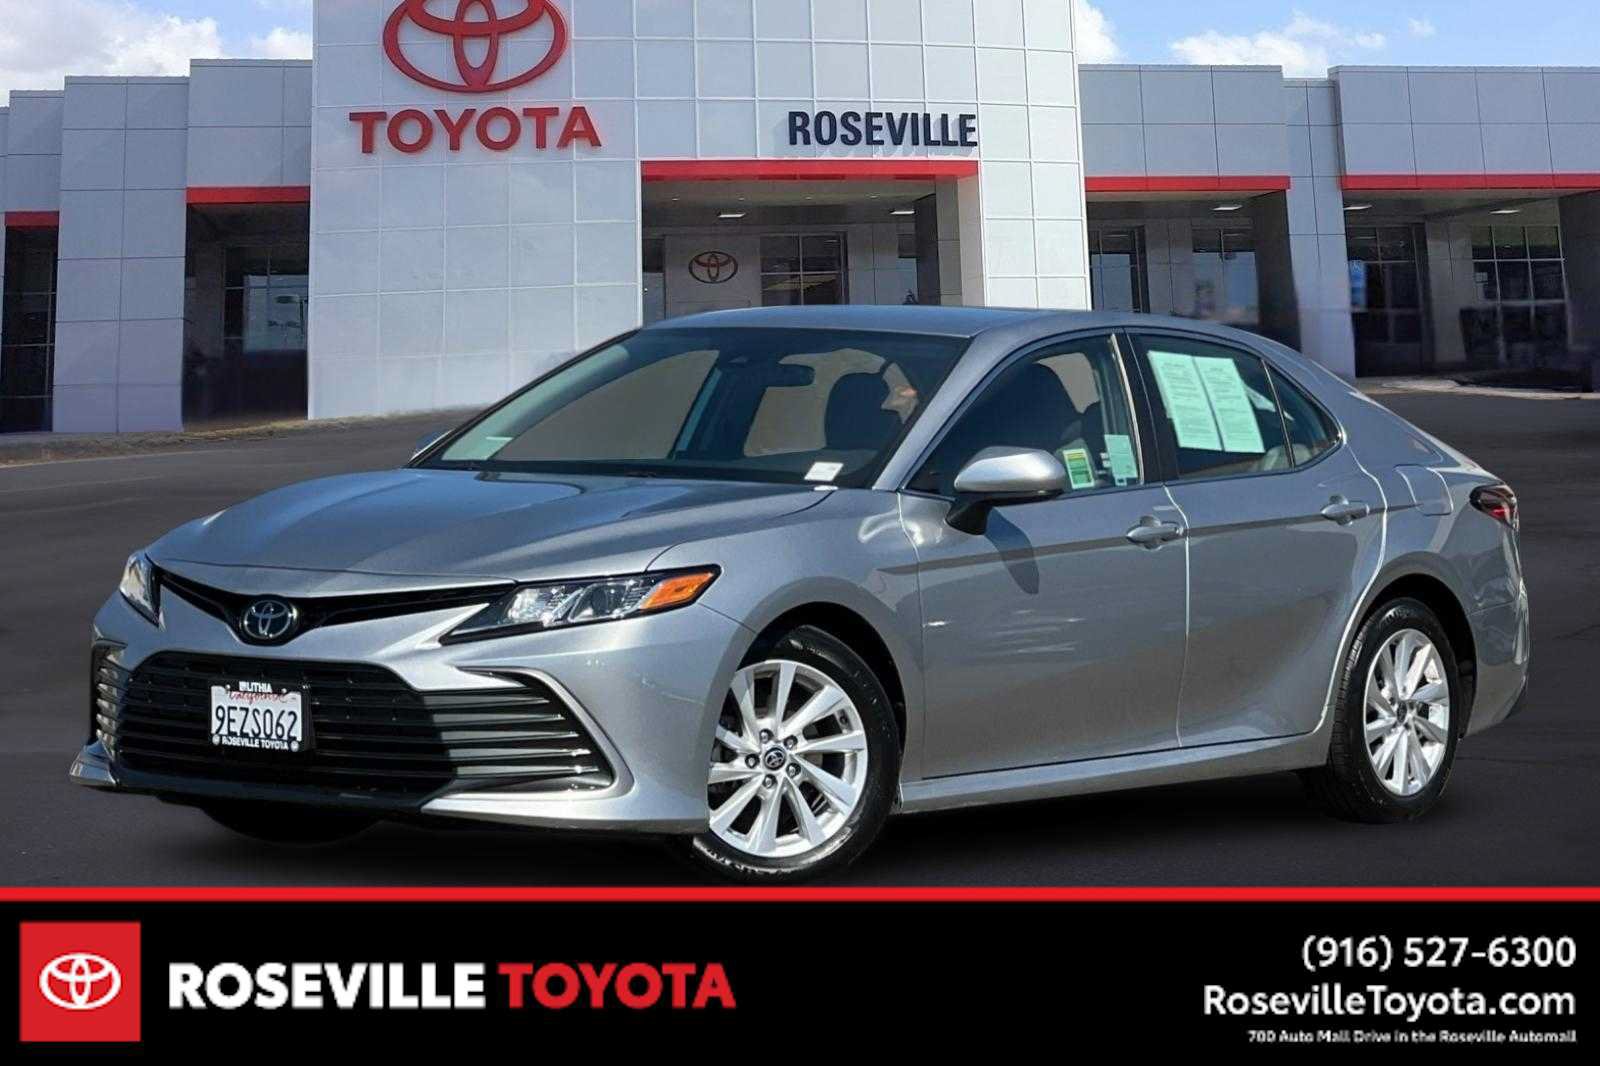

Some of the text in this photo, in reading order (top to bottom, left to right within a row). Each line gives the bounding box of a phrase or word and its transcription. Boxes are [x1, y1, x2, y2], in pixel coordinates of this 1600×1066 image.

[349, 106, 603, 154] TOYOTA
[788, 110, 978, 147] ROSEVILLE
[215, 705, 297, 741] 9EZS062
[222, 737, 289, 751] ROSEVILLE TOYOTA
